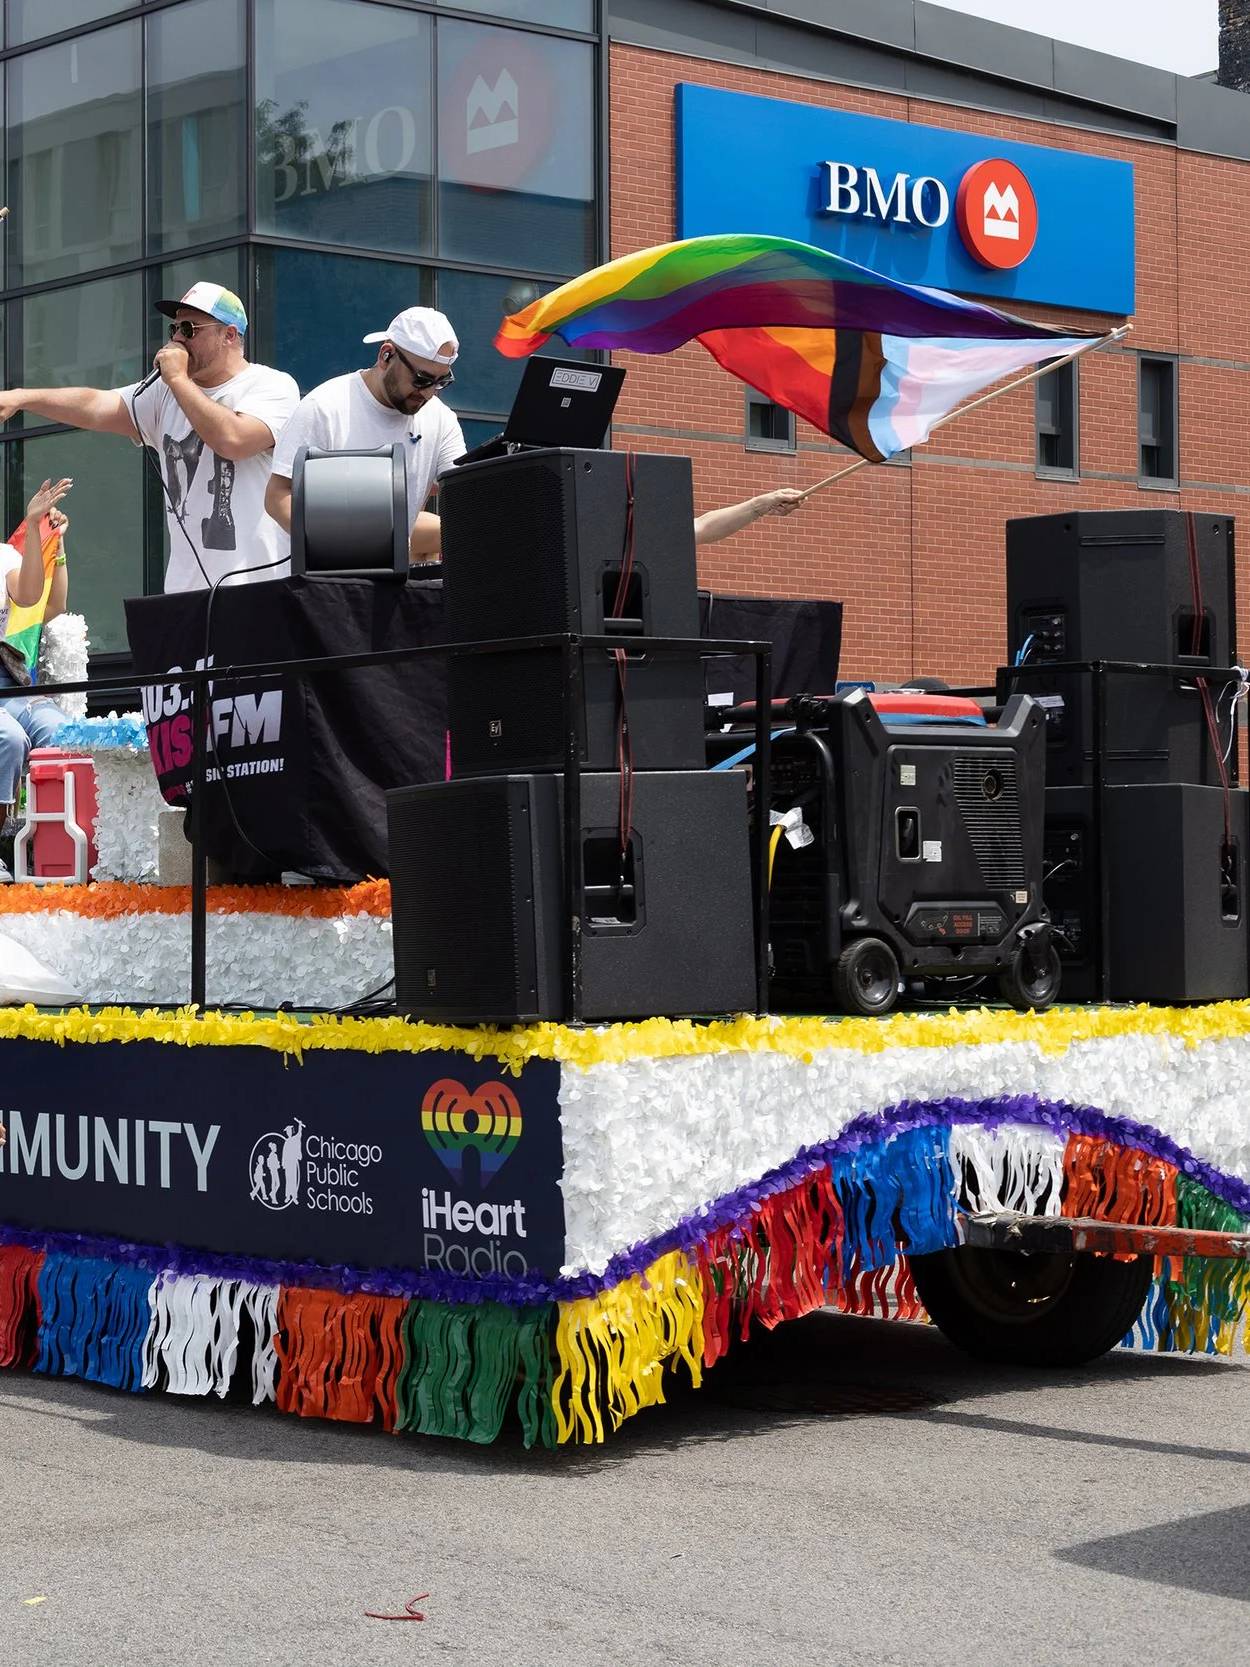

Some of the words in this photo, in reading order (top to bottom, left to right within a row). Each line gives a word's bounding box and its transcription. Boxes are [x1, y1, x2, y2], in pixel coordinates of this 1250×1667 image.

[823, 160, 949, 228] BMO
[205, 689, 283, 753] FM
[226, 758, 285, 779] STATION!
[306, 1134, 383, 1167] Chicago
[306, 1161, 359, 1187] Public
[306, 1186, 374, 1215] Schools
[421, 1187, 527, 1238] iHeart
[423, 1233, 528, 1281] Radio
